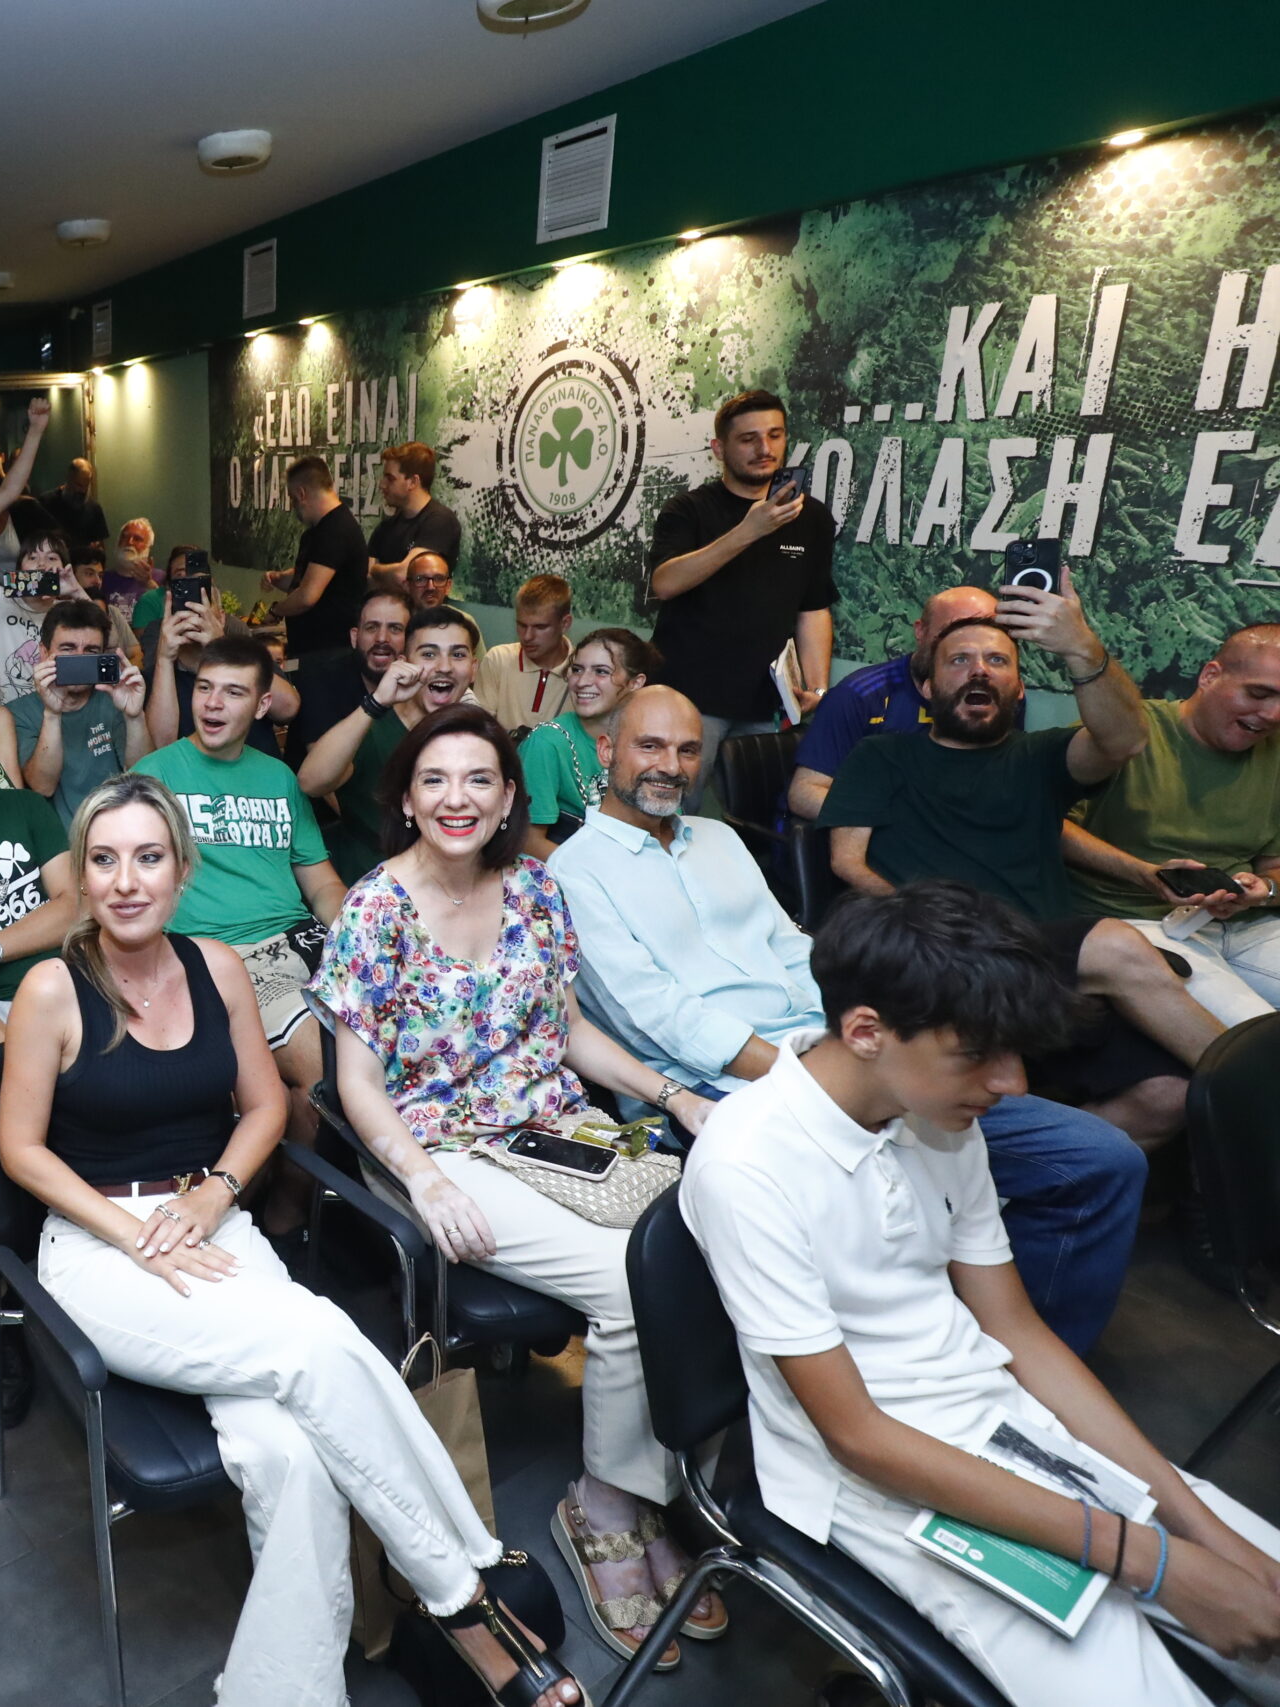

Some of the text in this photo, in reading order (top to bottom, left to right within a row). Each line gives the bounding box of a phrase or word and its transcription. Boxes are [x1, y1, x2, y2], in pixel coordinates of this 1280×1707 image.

[326, 372, 418, 445] ΕΙΝΑΙ
[525, 386, 604, 462] ΠΑΝΑΘΗΝΑΪΚΟΣ
[549, 492, 576, 506] 1908
[786, 433, 1114, 557] ΟΛΑΣΗ
[87, 731, 112, 748] NORTH
[90, 722, 105, 734] THE
[93, 743, 112, 757] FACE
[224, 795, 292, 823] ΑΘΗΝΑ
[275, 822, 292, 849] 13
